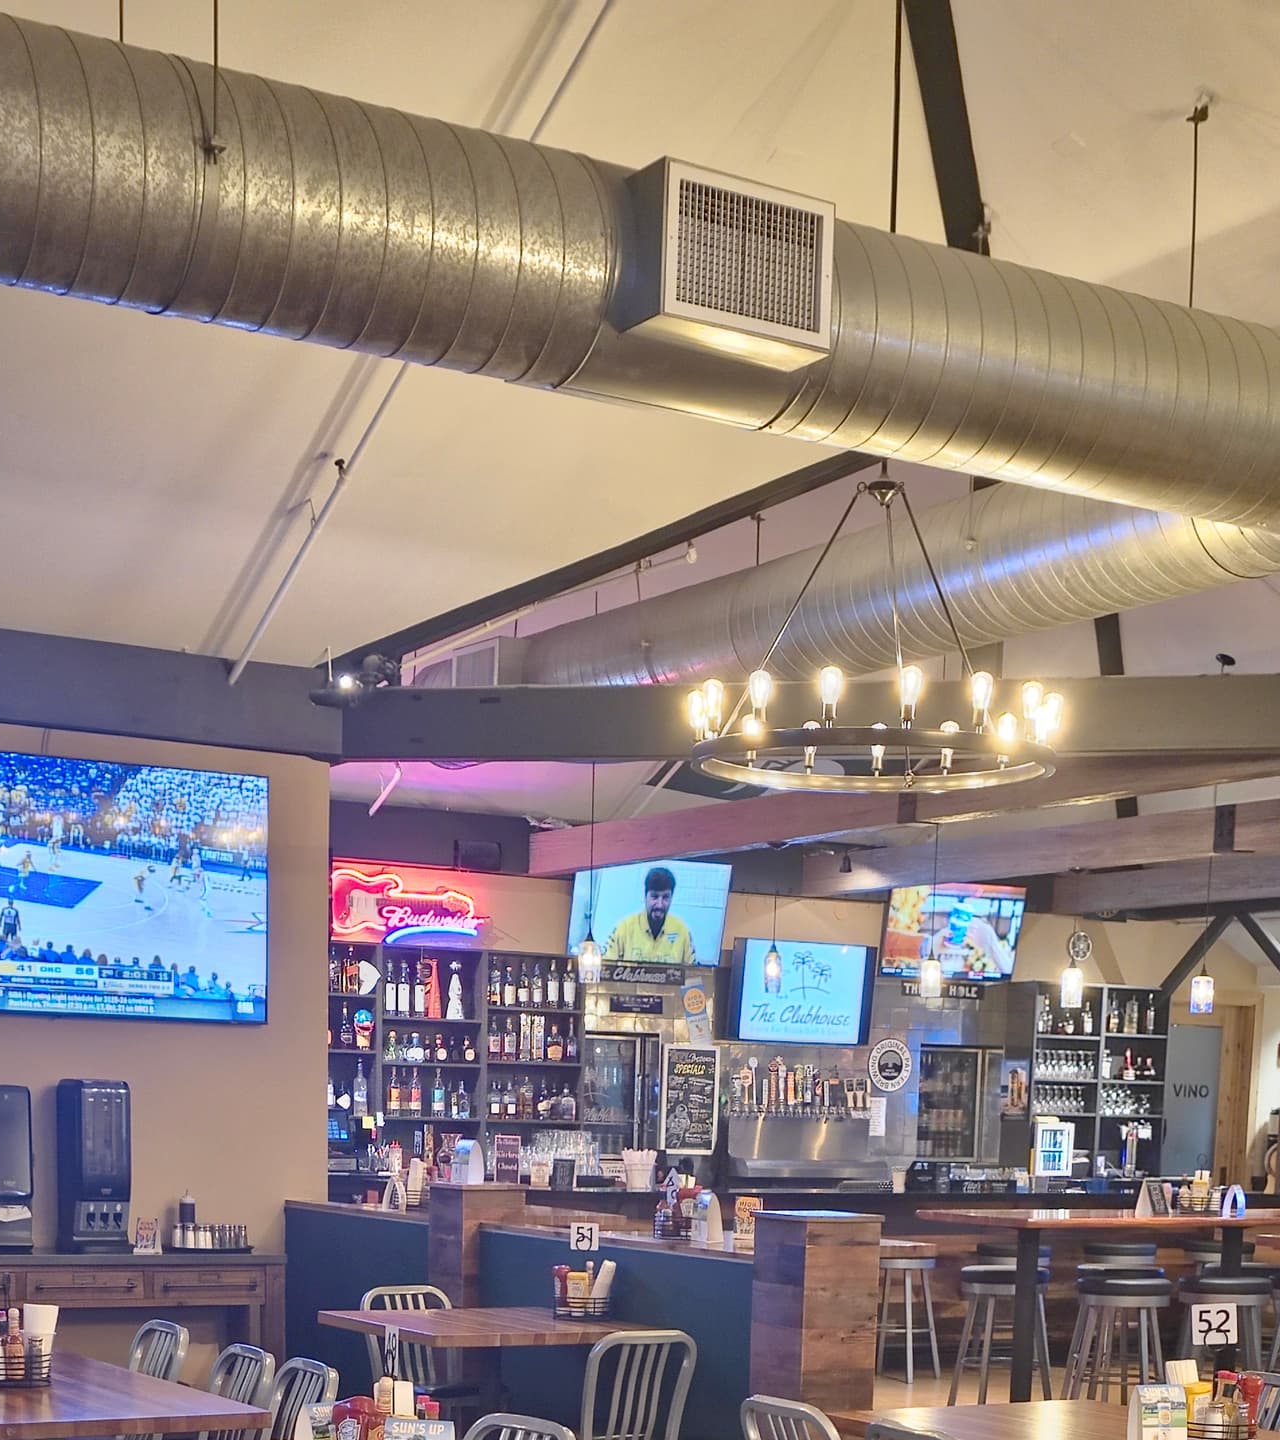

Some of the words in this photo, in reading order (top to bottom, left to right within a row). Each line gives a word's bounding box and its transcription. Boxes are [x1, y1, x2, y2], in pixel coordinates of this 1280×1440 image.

[381, 906, 484, 929] Budweiser
[16, 965, 32, 973] 41
[612, 967, 667, 983] Clubhouse
[903, 982, 921, 995] TH
[949, 985, 978, 998] HOLE
[750, 1002, 776, 1022] The
[777, 1004, 851, 1026] Clubhouse
[673, 1063, 706, 1075] SPECIALS
[1173, 1083, 1209, 1098] VINO
[576, 1226, 593, 1242] 51
[1198, 1309, 1231, 1334] 52
[312, 1405, 333, 1417] SUN
[391, 1421, 426, 1435] SUN'S
[428, 1424, 445, 1436] UP
